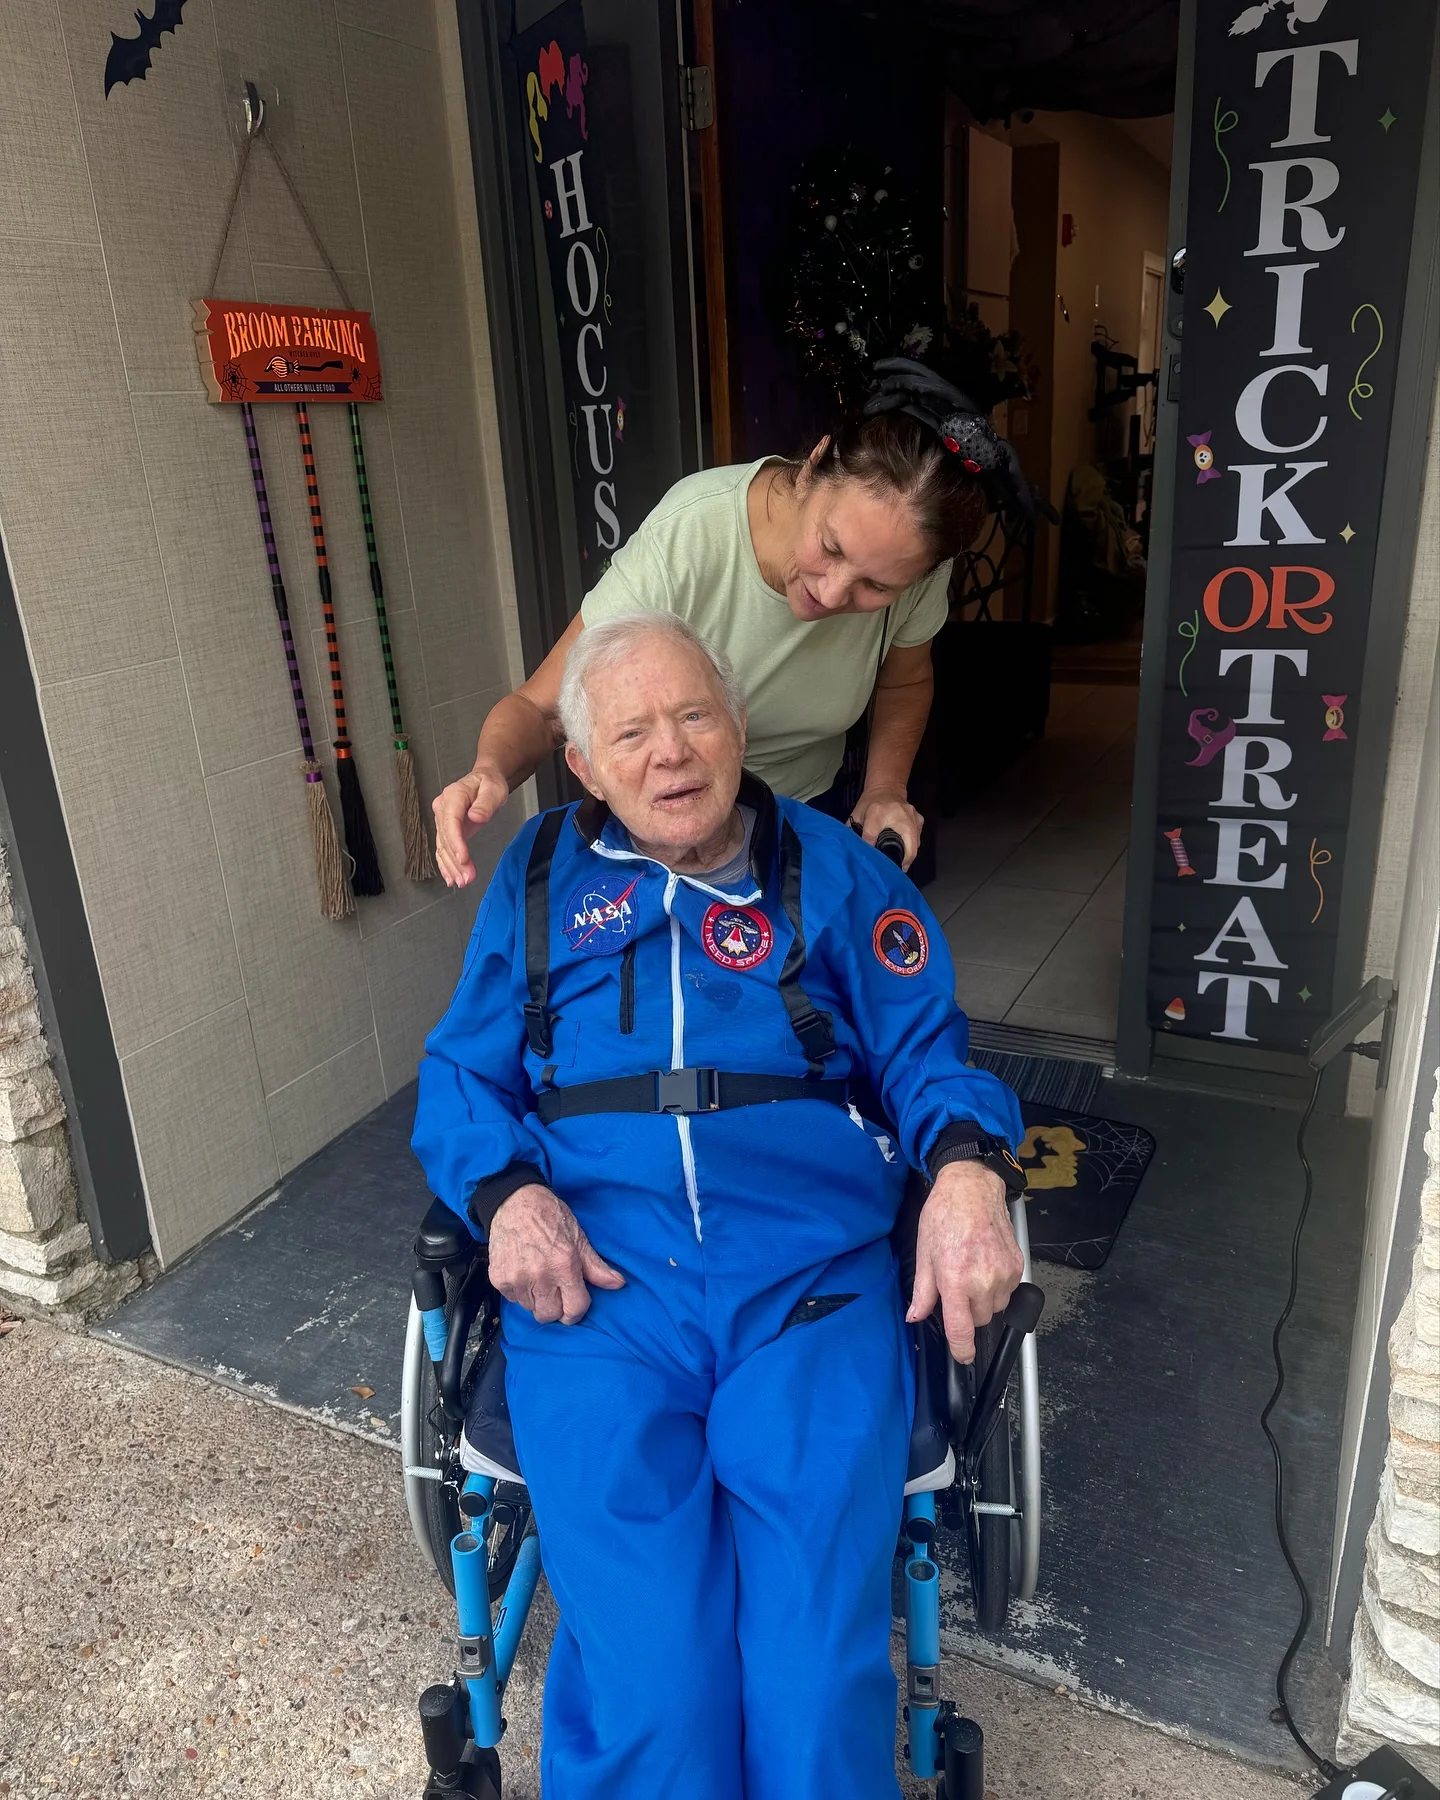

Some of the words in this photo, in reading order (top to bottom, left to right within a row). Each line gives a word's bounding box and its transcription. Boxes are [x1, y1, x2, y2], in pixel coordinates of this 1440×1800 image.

[1223, 38, 1359, 547] TRICK
[223, 311, 290, 360] BROOM
[290, 314, 366, 363] PARKING
[549, 149, 621, 550] HOCUS
[274, 383, 284, 392] ALL
[284, 383, 303, 392] OTHERS
[303, 383, 316, 392] WILL
[316, 383, 323, 392] BE
[323, 383, 336, 392] TOAD
[1202, 565, 1336, 635] OR
[1193, 648, 1308, 1043] TREAT
[574, 900, 632, 929] NASA
[705, 932, 732, 965] NEED
[735, 939, 769, 967] SPACE
